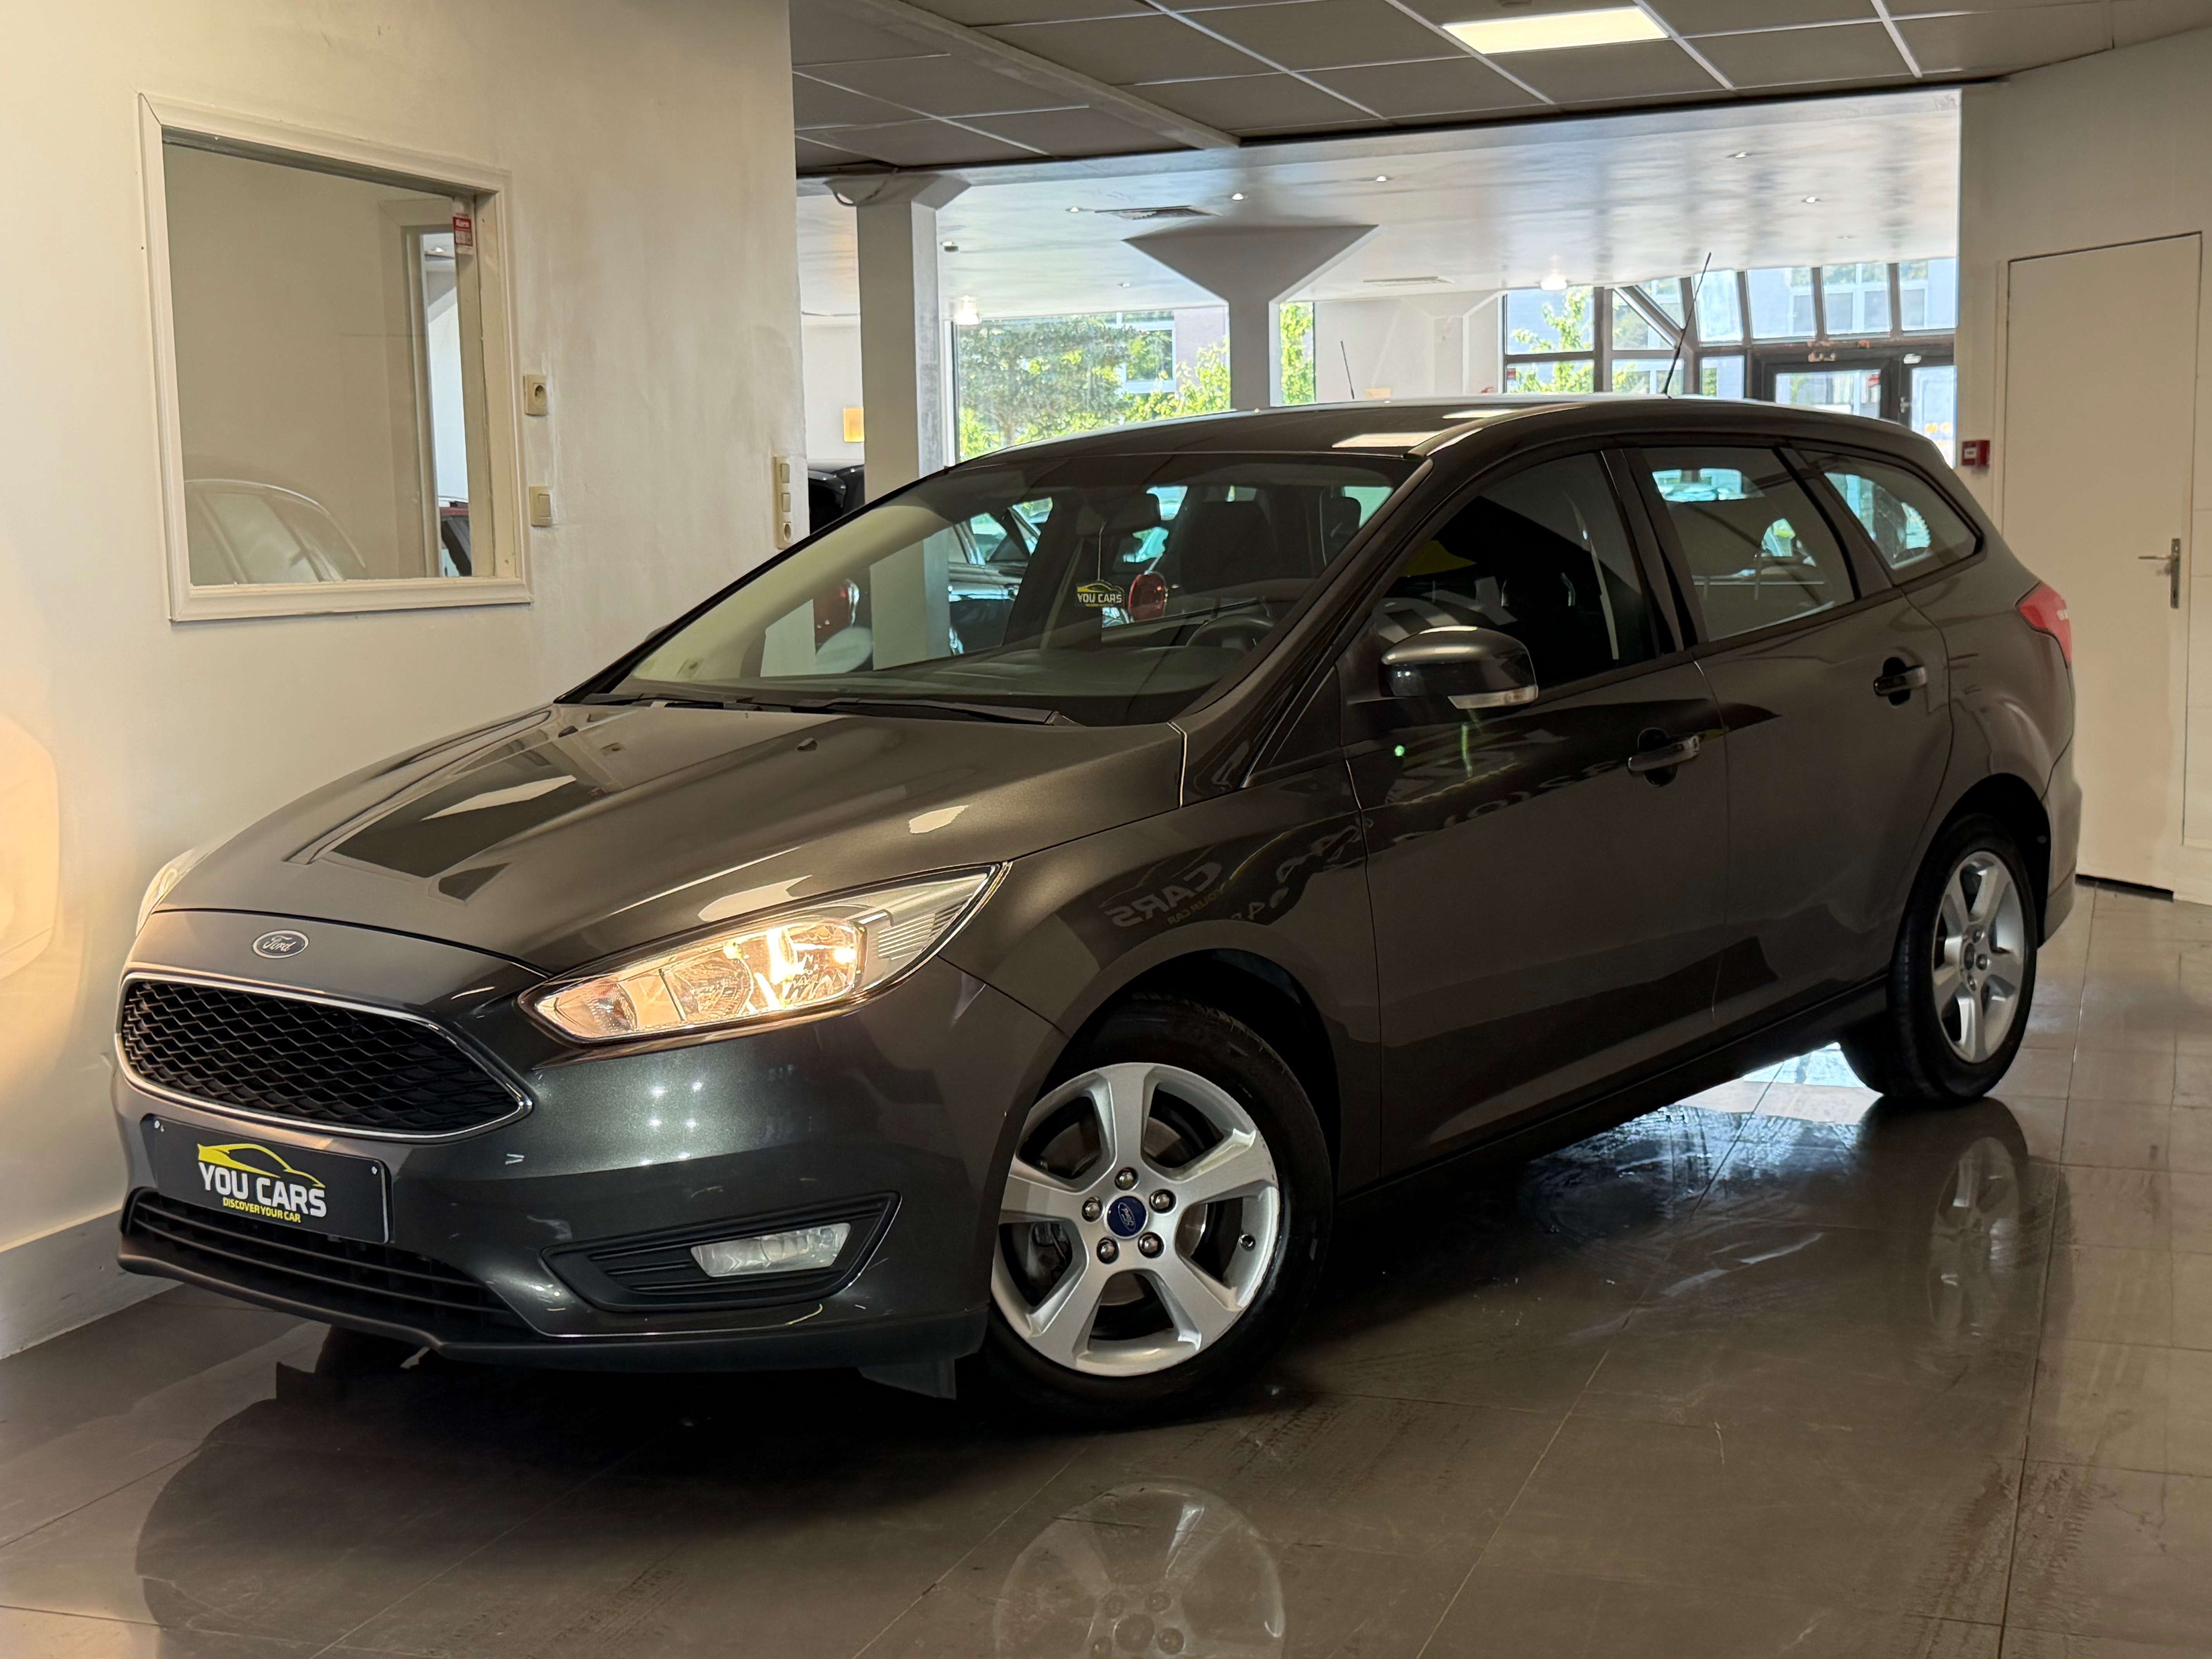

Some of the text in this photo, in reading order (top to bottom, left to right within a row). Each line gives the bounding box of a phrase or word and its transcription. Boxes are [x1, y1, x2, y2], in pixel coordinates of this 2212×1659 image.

[1077, 593, 1122, 603] YOU CARS
[262, 935, 297, 952] Ford
[198, 1162, 327, 1218] YOU CARS
[223, 1197, 301, 1223] DISCOVER YOUR CAR
